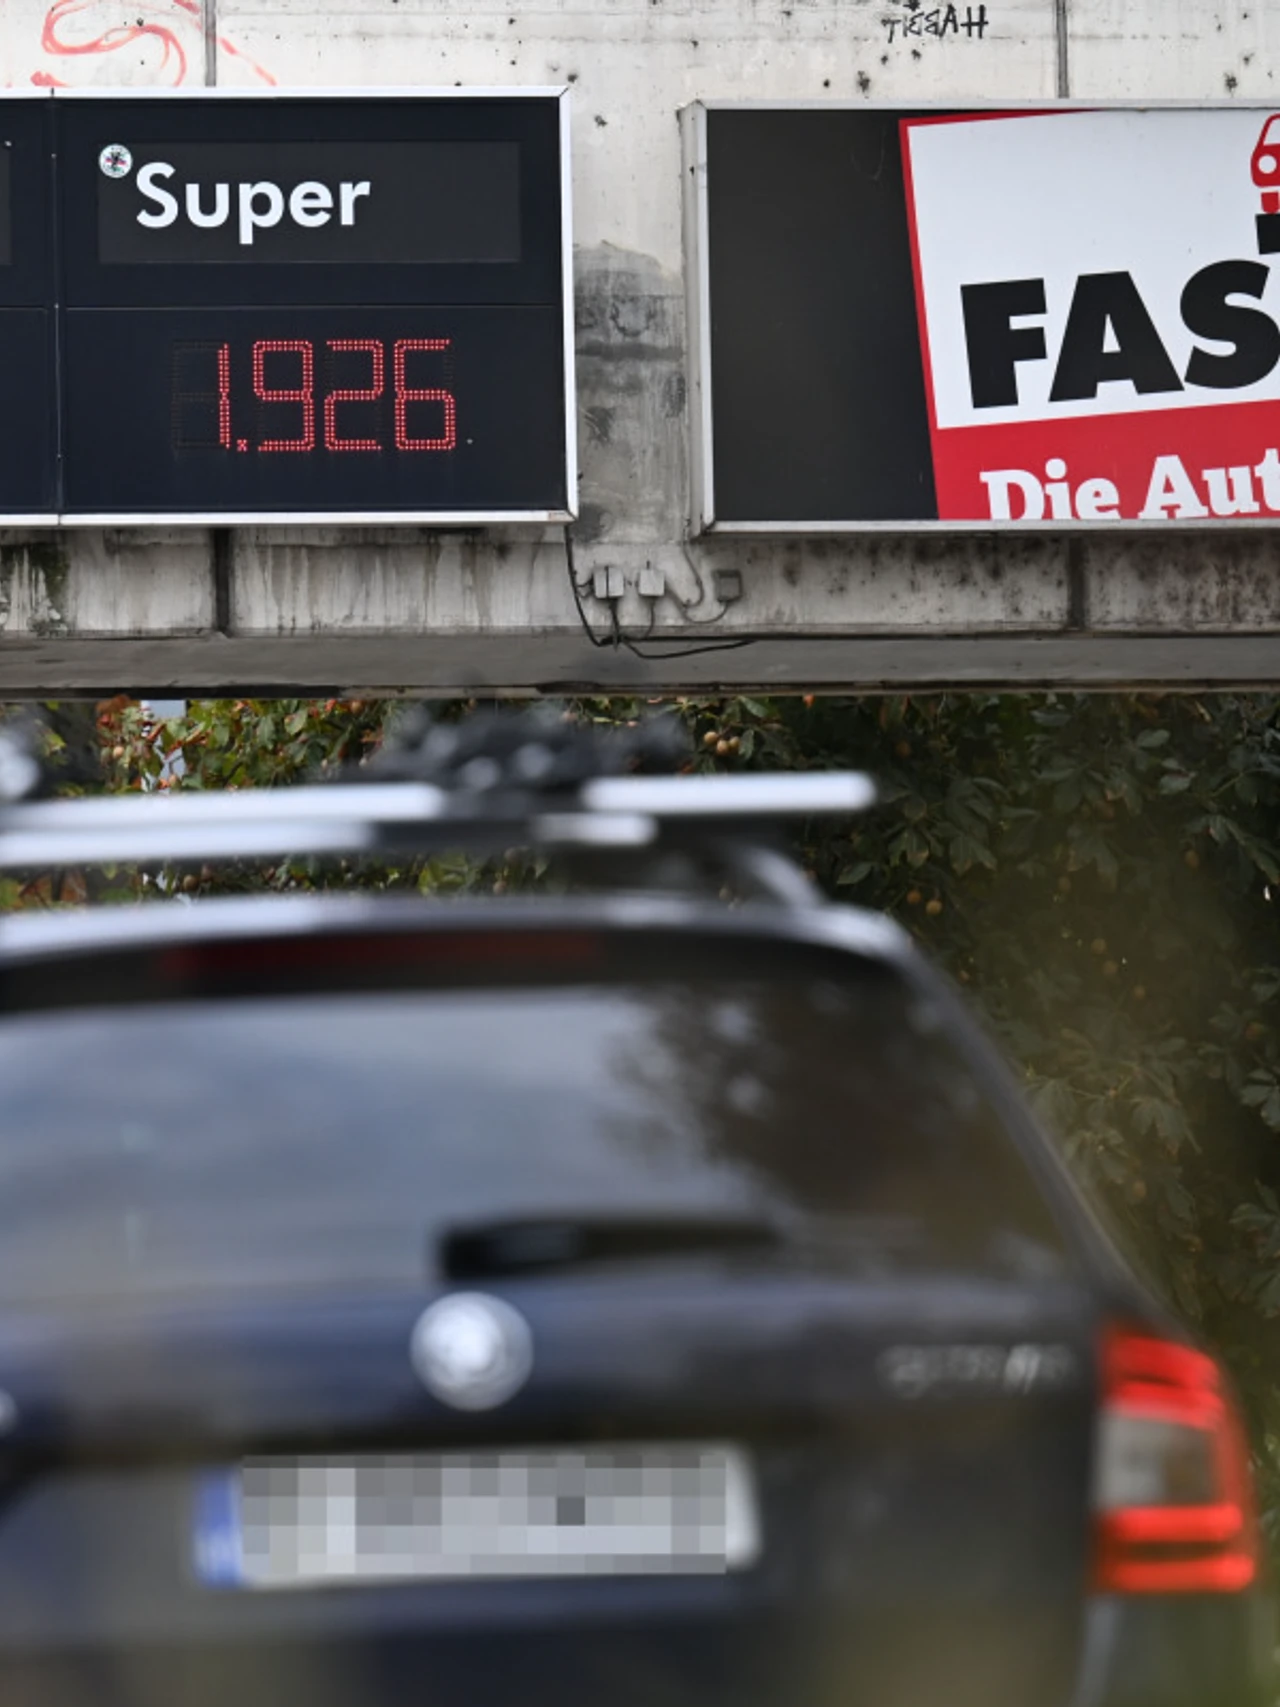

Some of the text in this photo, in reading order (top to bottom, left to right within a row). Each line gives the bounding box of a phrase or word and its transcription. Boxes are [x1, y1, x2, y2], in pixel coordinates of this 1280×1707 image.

[136, 162, 372, 245] Super
[960, 214, 1280, 409] FAS
[218, 338, 457, 453] 1.926
[979, 448, 1280, 520] Die Aut
